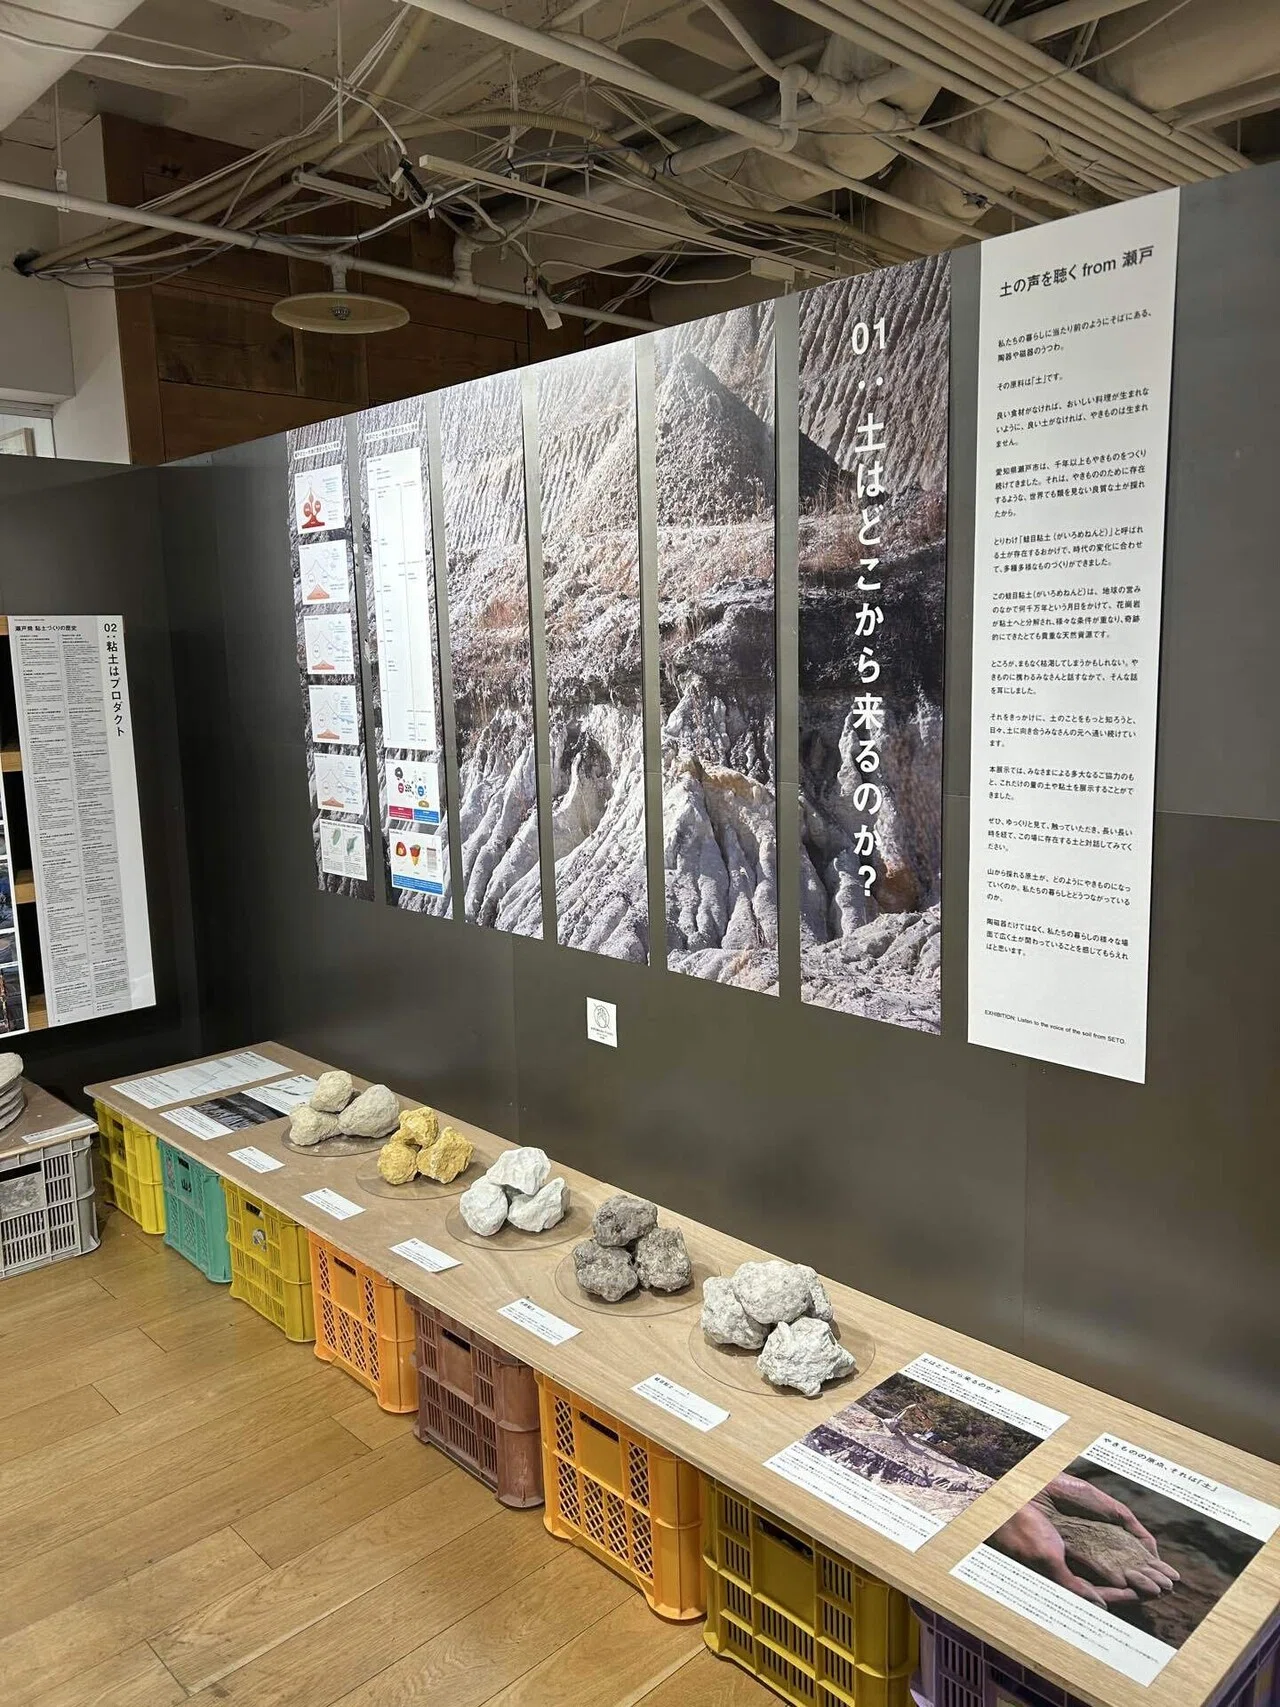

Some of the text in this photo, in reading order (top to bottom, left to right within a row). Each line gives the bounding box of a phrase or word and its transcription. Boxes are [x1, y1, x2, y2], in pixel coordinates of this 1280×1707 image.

[999, 245, 1155, 299] 土の声を聴く from 瀬戸
[852, 317, 885, 355] 01
[997, 438, 1019, 448] ません。
[995, 508, 1017, 518] たから。
[104, 623, 117, 632] 02
[852, 412, 887, 897] 土はどこから来るのか？
[106, 640, 124, 737] 粘土はプロダクト
[989, 792, 1016, 800] きました。
[988, 844, 1010, 852] ださい。
[987, 894, 1004, 902] のか。
